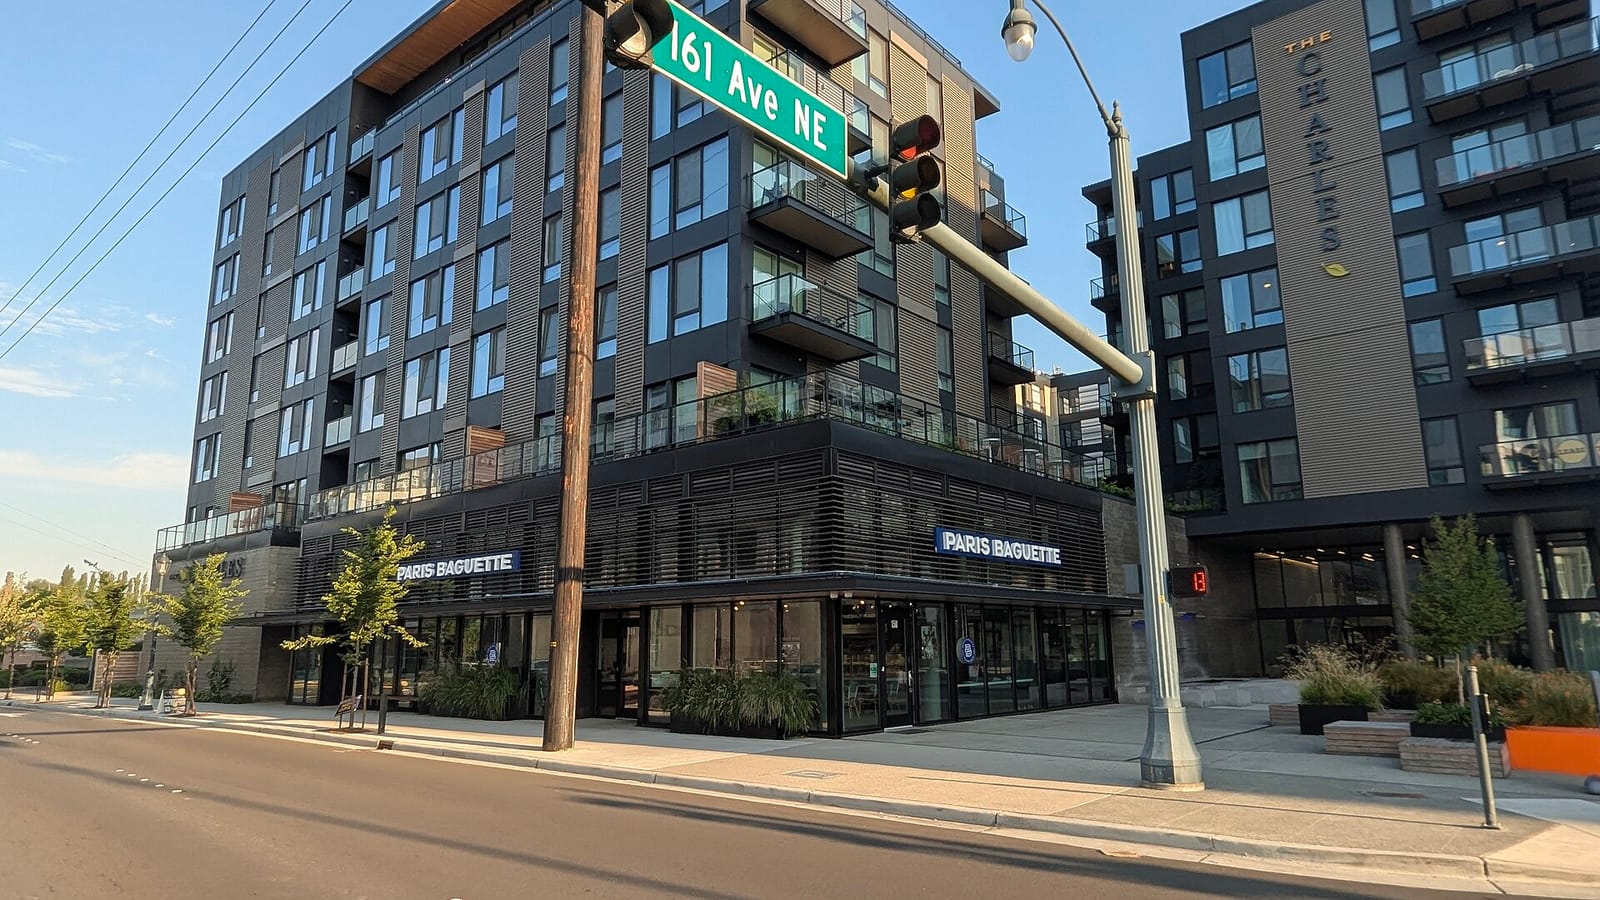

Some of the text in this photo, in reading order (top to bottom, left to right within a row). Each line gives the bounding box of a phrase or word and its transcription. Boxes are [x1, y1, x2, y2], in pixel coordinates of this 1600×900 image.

[1284, 30, 1332, 53] THE
[671, 20, 828, 152] 161 Ave NE
[1296, 52, 1342, 252] CHARLES
[942, 531, 1062, 564] PARIS BAGUETTE
[397, 553, 513, 580] PARIS BAGUETTE
